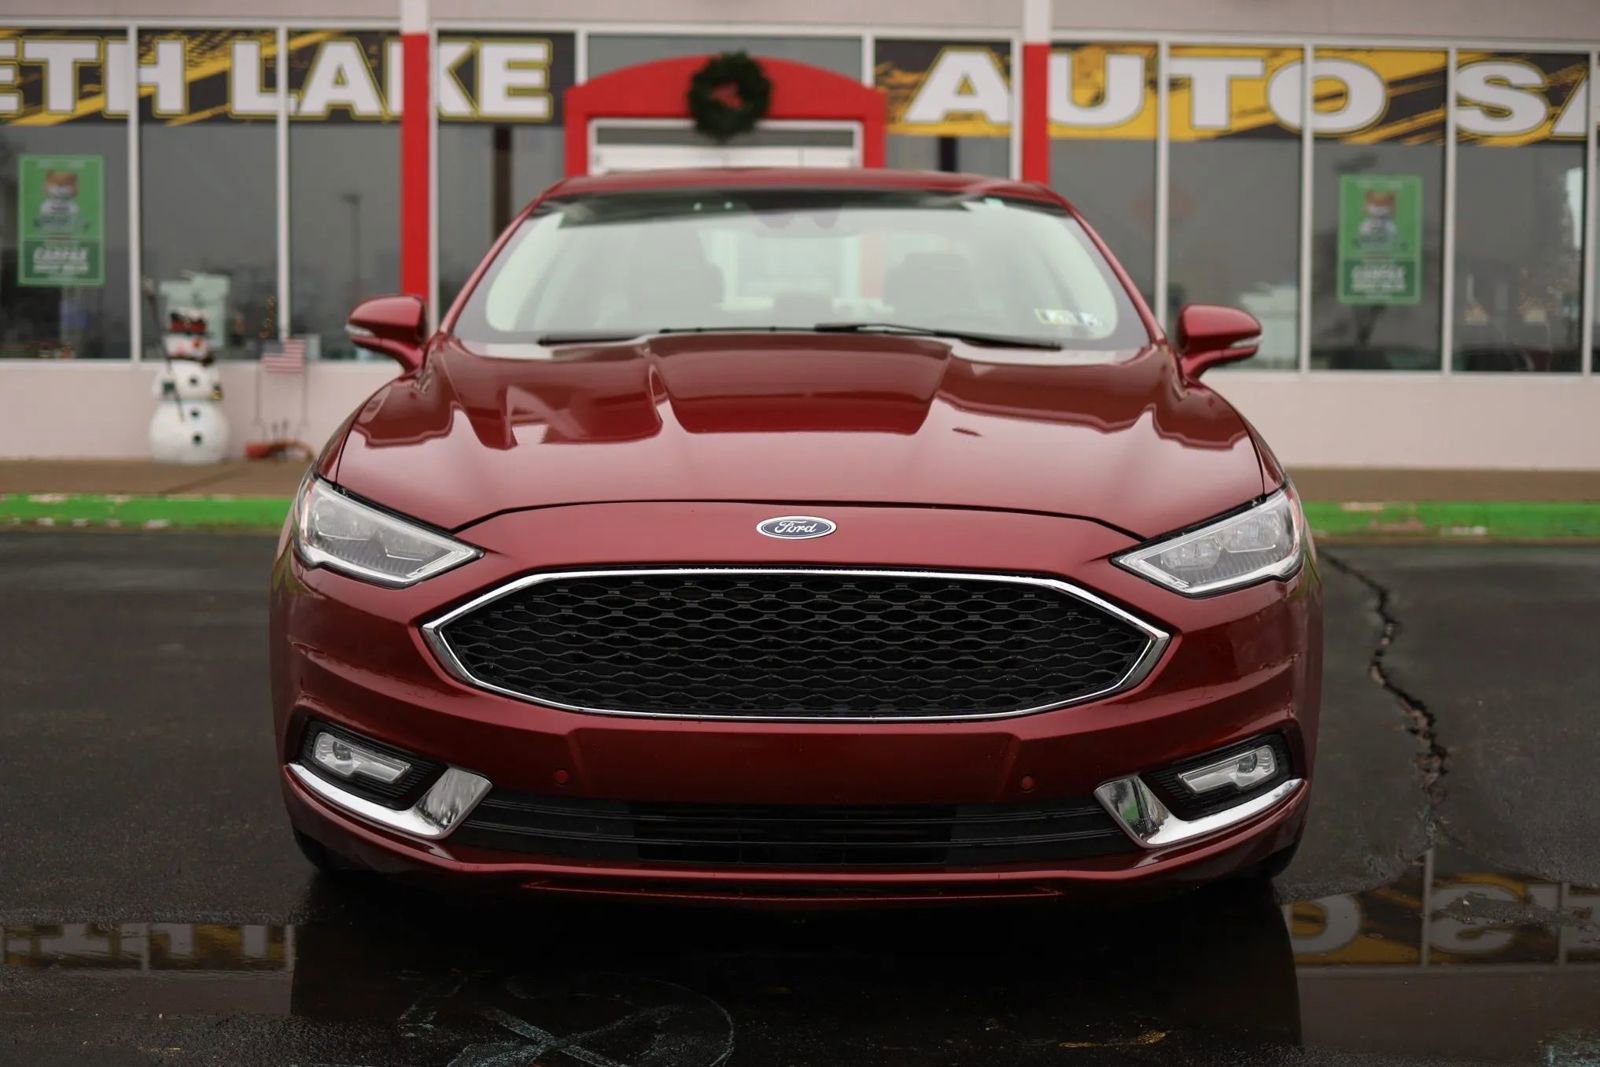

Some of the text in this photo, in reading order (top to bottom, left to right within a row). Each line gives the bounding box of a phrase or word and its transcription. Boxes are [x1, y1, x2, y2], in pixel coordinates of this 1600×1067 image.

[0, 39, 186, 113] TH
[231, 40, 549, 118] LAKE
[903, 47, 1388, 132] AUTO
[774, 519, 817, 533] Ford
